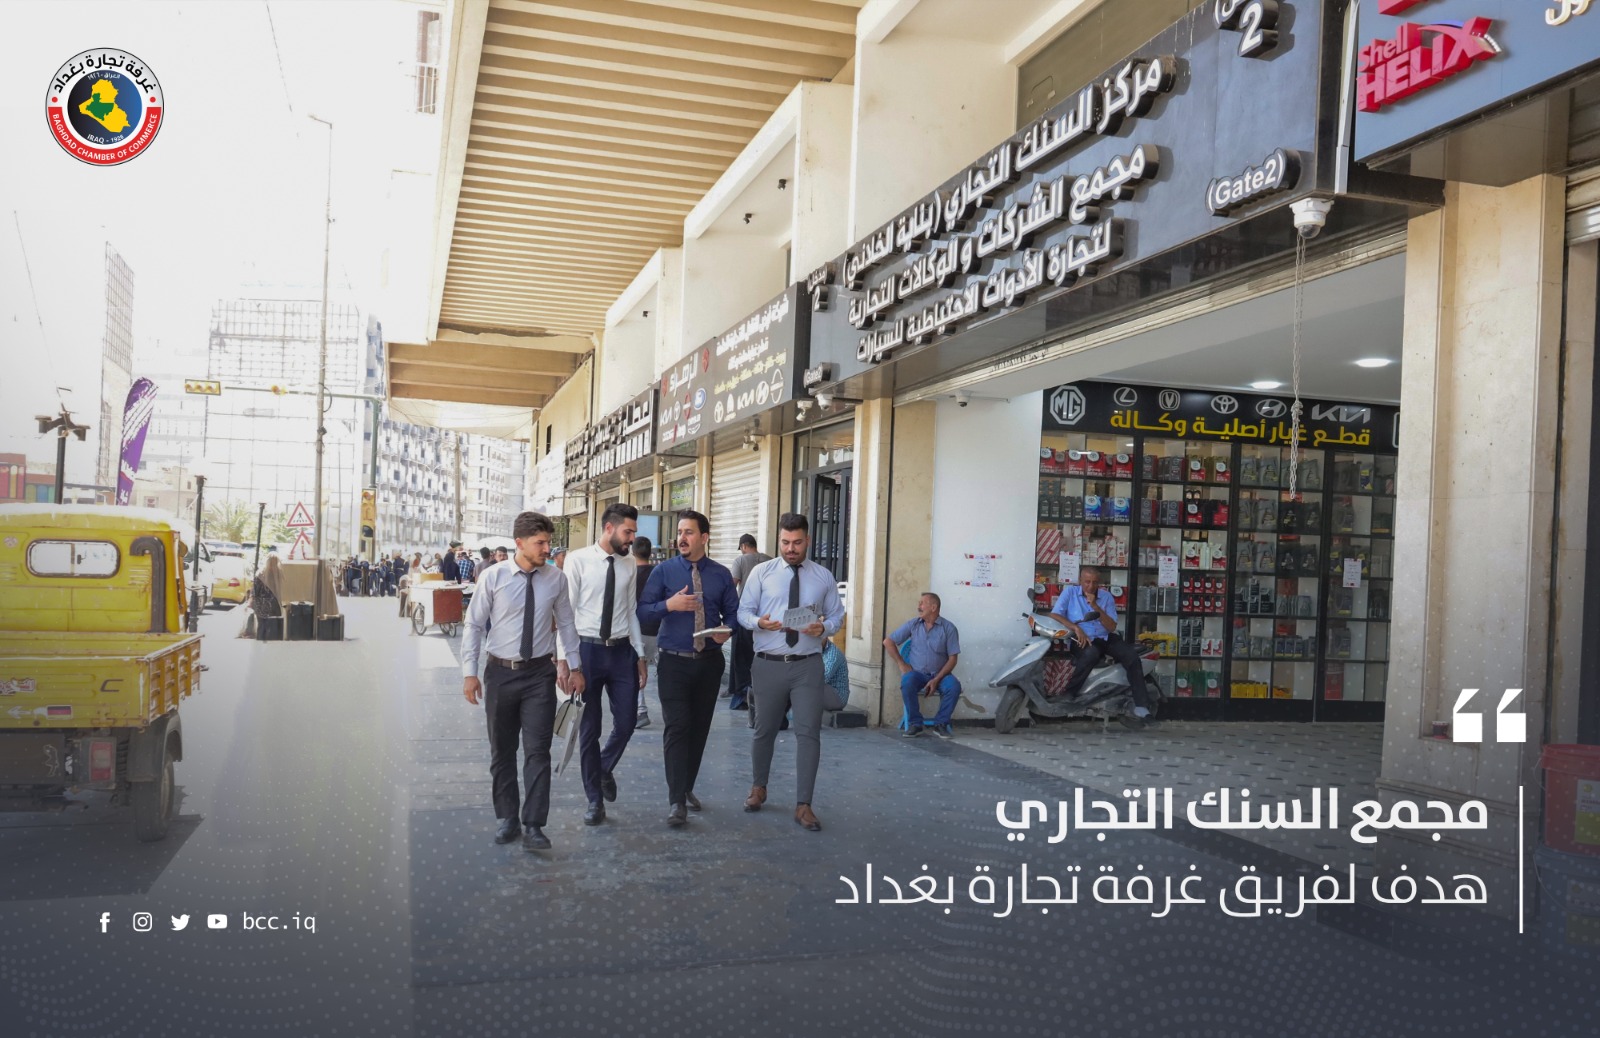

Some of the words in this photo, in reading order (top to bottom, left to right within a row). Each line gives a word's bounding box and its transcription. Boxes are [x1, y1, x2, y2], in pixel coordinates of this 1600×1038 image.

[1239, 1, 1262, 56] 2
[1357, 16, 1496, 112] HELIX
[1097, 58, 1162, 134] مركز
[1015, 83, 1094, 172] السنك
[944, 144, 1010, 232] التجاري
[1069, 145, 1146, 224] مجمع
[1207, 152, 1284, 213] (Gate2)
[977, 174, 1064, 258] الشركات
[898, 235, 958, 300] الوكالات
[960, 237, 972, 274] و
[982, 249, 1044, 306] الأدوات
[1048, 218, 1111, 286] لتجارة
[849, 275, 895, 329] التجارية
[906, 281, 979, 345] الاحتياطية
[856, 317, 904, 364] للسيارات
[1052, 389, 1083, 421] MG
[1110, 409, 1187, 437] وكالة
[1193, 416, 1266, 440] أصلية
[1311, 403, 1372, 424] KIA
[1313, 426, 1371, 447] قطع
